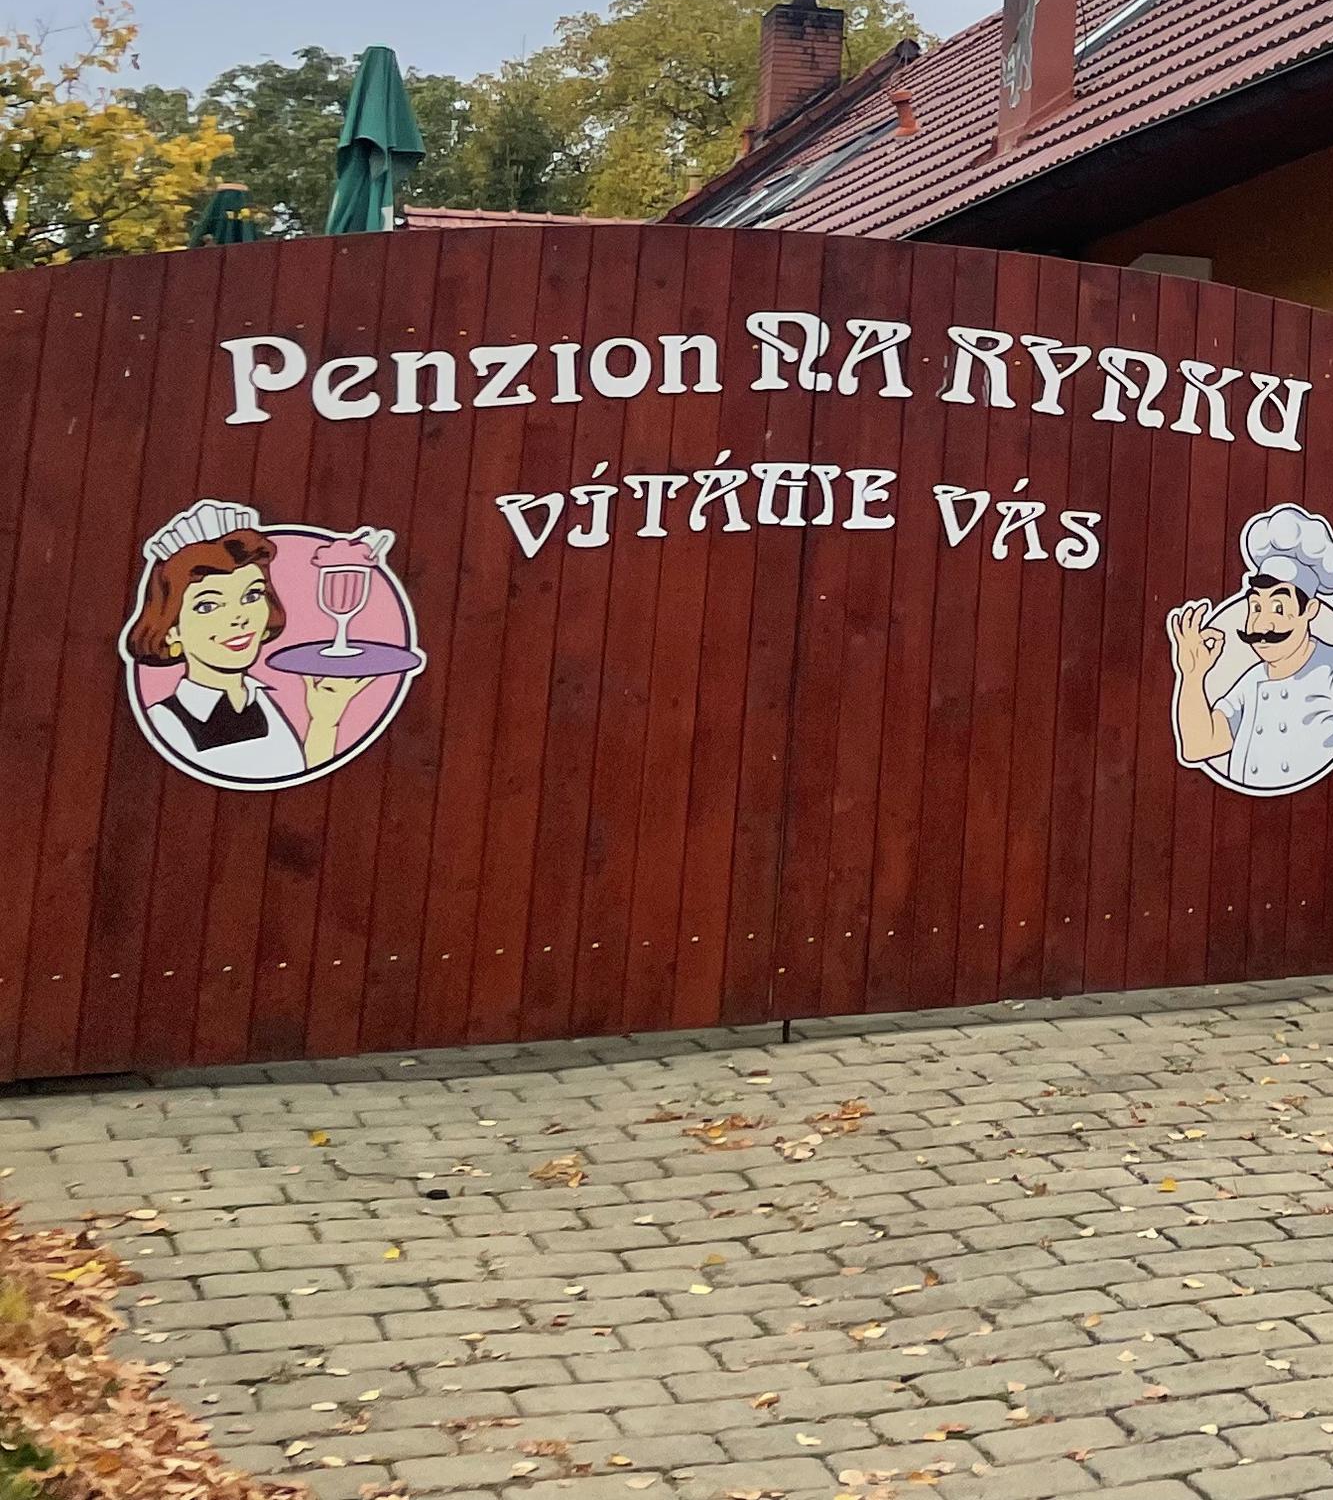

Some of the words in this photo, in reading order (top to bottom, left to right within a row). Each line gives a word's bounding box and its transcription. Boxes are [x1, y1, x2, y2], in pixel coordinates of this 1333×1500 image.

[219, 333, 723, 424] Penzion
[745, 311, 913, 398] NA
[940, 325, 1312, 452] RYNKU
[496, 450, 897, 558] VÍTÁME
[932, 477, 1101, 570] VÁS
